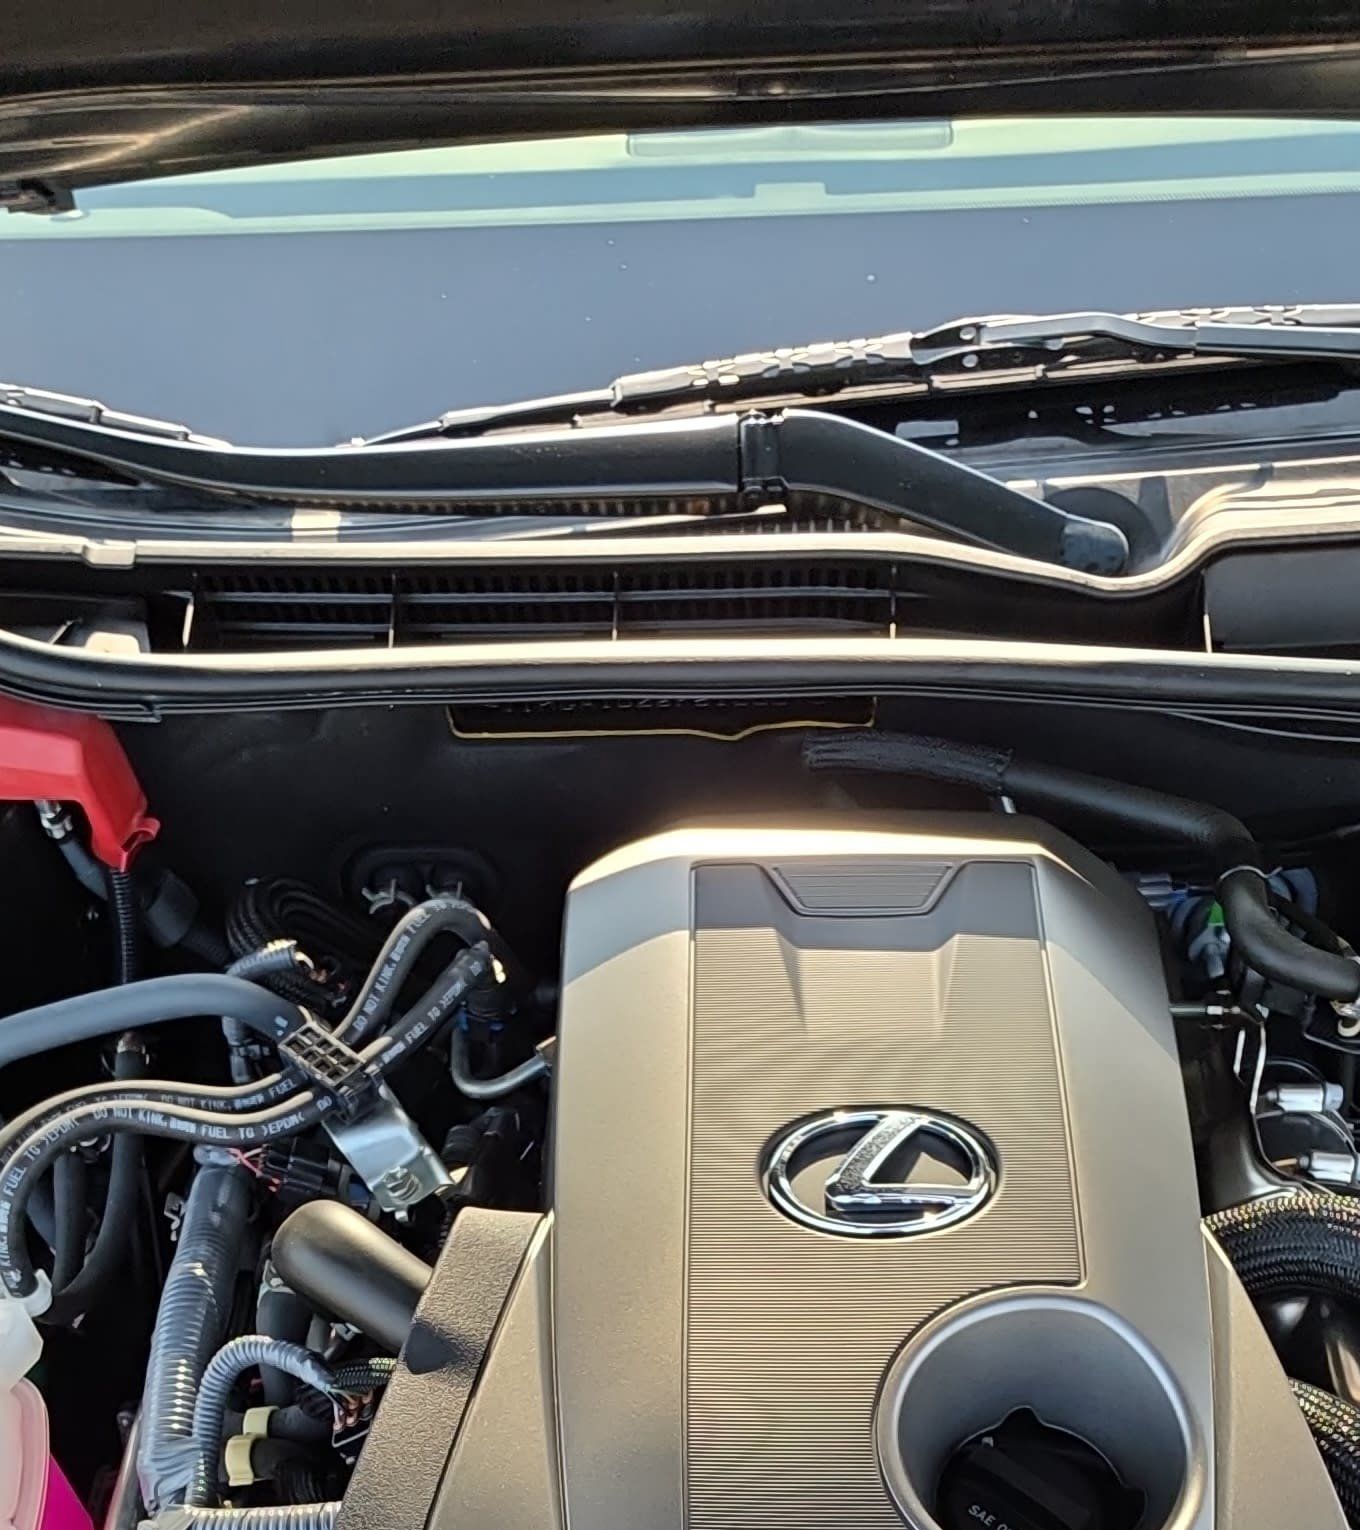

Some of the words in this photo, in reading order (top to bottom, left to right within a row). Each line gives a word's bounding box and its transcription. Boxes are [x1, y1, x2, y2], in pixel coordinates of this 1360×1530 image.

[362, 993, 381, 1016] NOT
[406, 912, 432, 934] FUEL
[404, 1022, 429, 1044] FUEL
[427, 1005, 442, 1021] TO
[269, 1080, 297, 1098] FUEL
[4, 1165, 27, 1195] FUEL
[24, 1142, 41, 1161] TO
[93, 1106, 109, 1120] DO
[113, 1105, 134, 1119] NOT
[200, 1124, 233, 1140] FUEL
[240, 1126, 255, 1139] TO
[316, 1094, 333, 1112] DO
[967, 1503, 996, 1527] SAE
